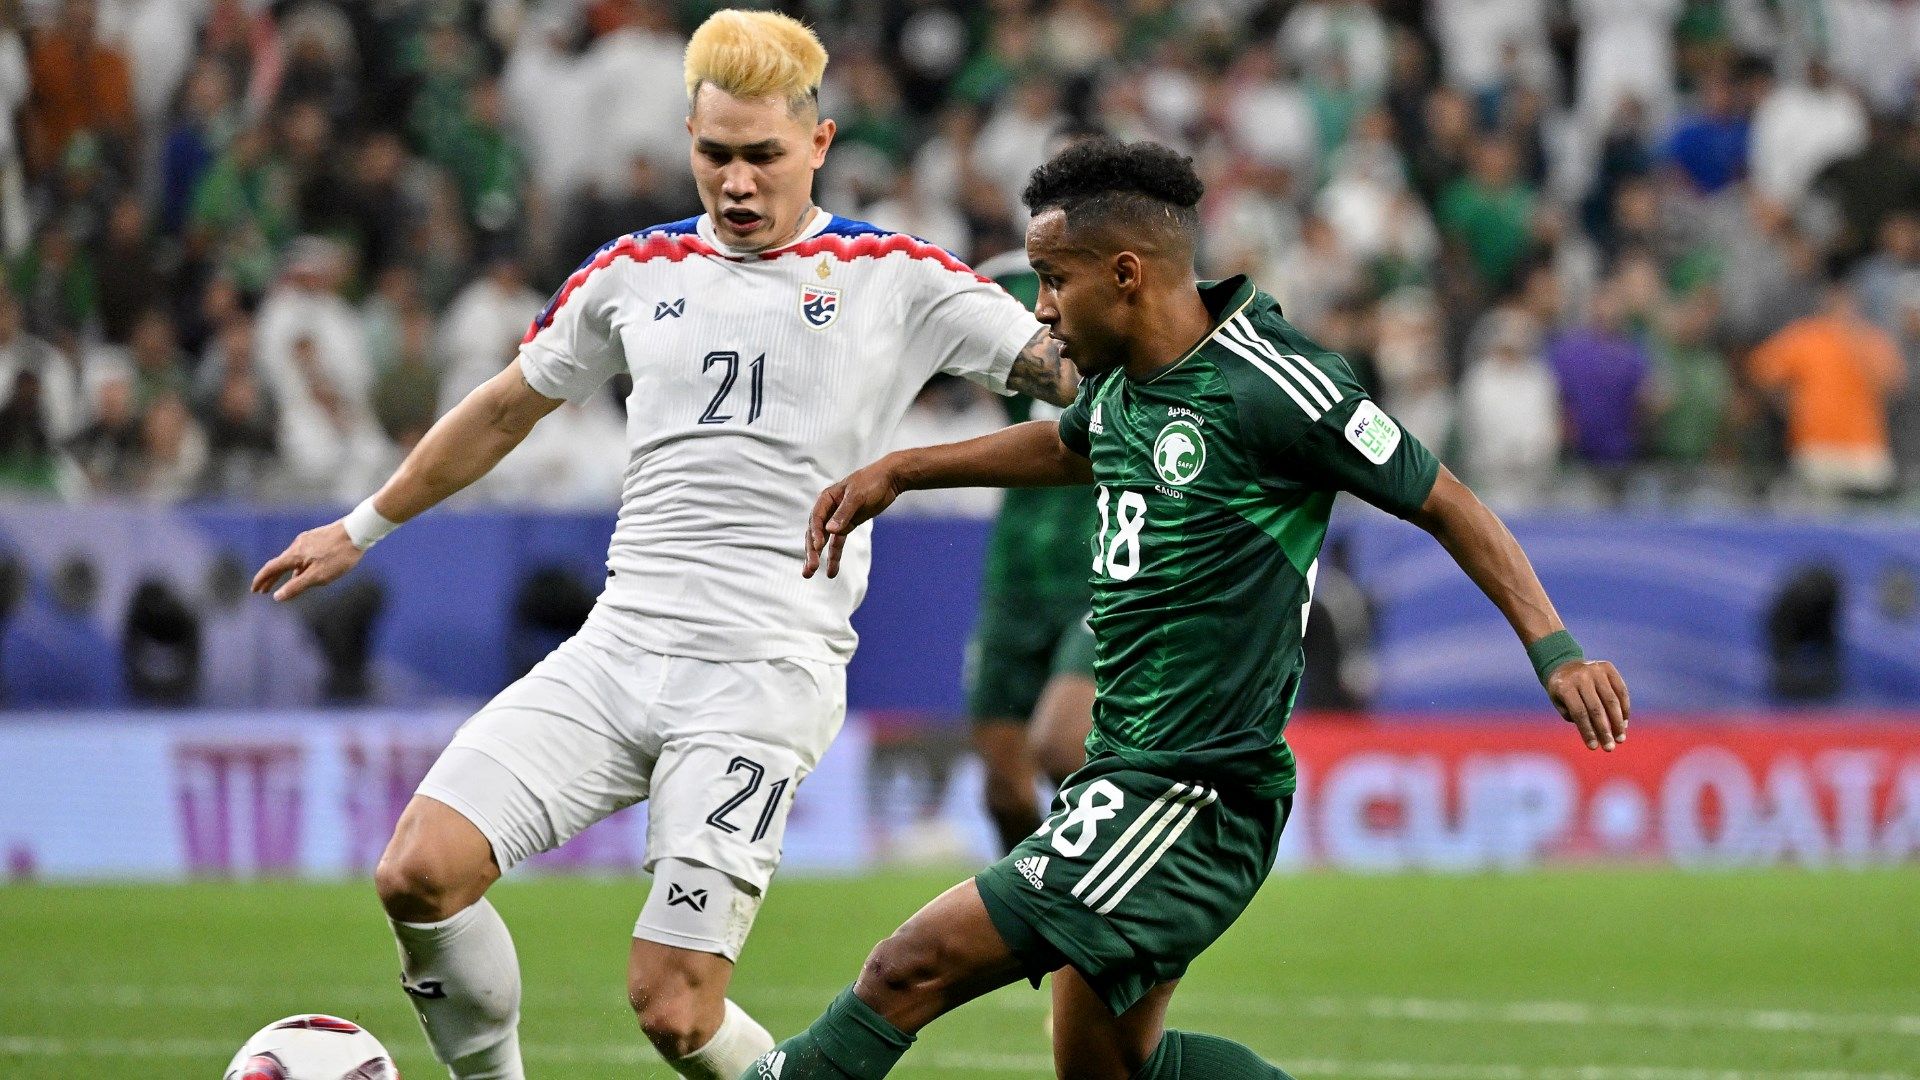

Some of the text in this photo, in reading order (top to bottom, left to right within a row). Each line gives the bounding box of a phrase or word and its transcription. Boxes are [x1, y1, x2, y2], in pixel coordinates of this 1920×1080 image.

[698, 351, 765, 425] 21
[1167, 406, 1205, 426] السعودية
[1354, 417, 1370, 438] AFC
[1360, 414, 1385, 448] LIVE
[1177, 460, 1194, 470] SAFF
[1154, 484, 1184, 500] SAUDI
[1092, 485, 1147, 581] 18
[705, 755, 790, 844] 21
[1320, 752, 1578, 870] CUP
[1036, 778, 1125, 858] 18
[1014, 858, 1044, 890] adidas
